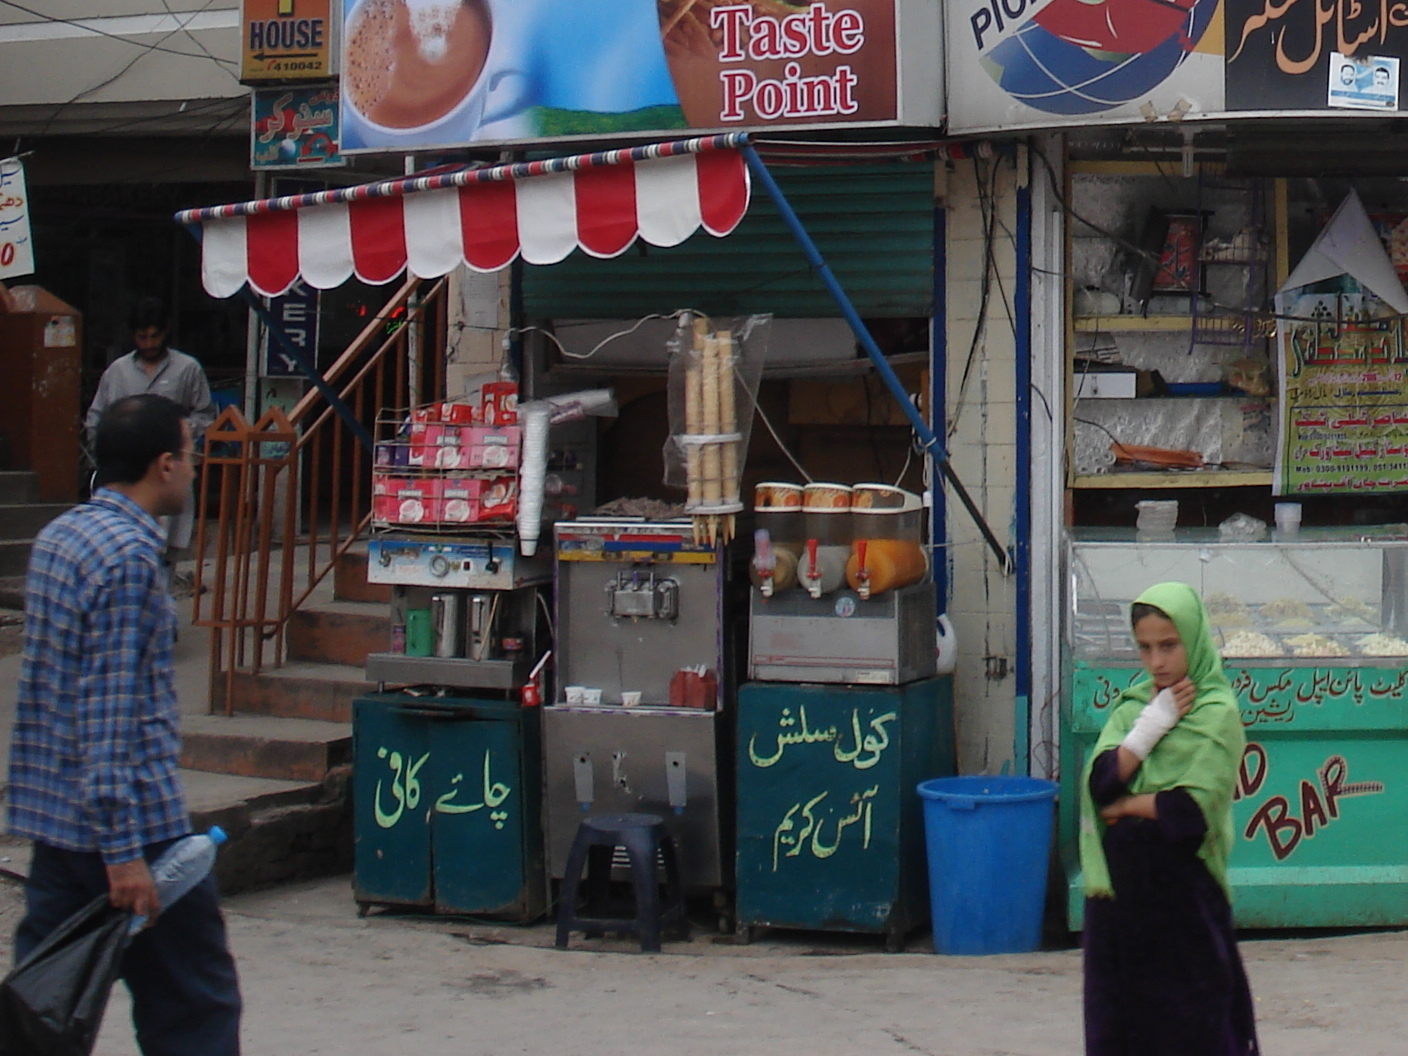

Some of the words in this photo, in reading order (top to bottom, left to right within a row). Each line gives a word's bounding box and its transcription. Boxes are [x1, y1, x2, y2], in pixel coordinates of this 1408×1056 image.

[250, 20, 323, 49] HOUSE
[711, 4, 865, 60] Taste
[274, 61, 322, 71] 410042
[719, 65, 857, 120] Point
[1249, 669, 1294, 702] مکس
[749, 704, 837, 768] سلش
[375, 746, 430, 829] کافی
[436, 747, 511, 830] چائے
[1244, 756, 1384, 861] BAR
[772, 791, 829, 873] کریم
[811, 784, 880, 859] آئس
